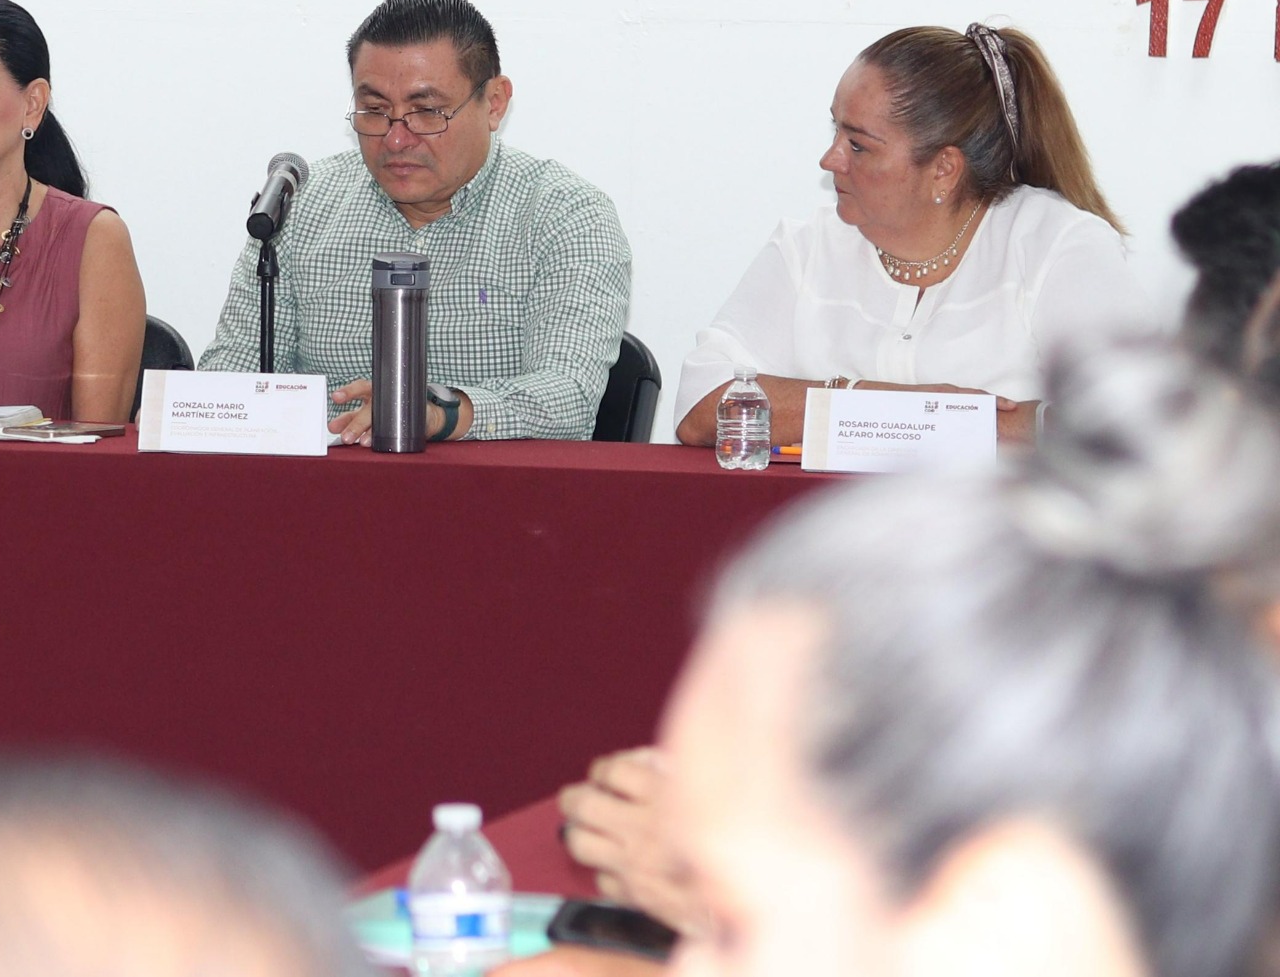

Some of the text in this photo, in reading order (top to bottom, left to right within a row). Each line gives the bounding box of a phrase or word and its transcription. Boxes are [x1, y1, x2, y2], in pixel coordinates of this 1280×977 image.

[172, 401, 214, 409] GONZALO
[171, 410, 249, 420] MARTÍNEZ GÓMEZ
[838, 420, 936, 432] ROSARIO GUADALUPE
[837, 430, 922, 441] ALFARO MOSCOSO
